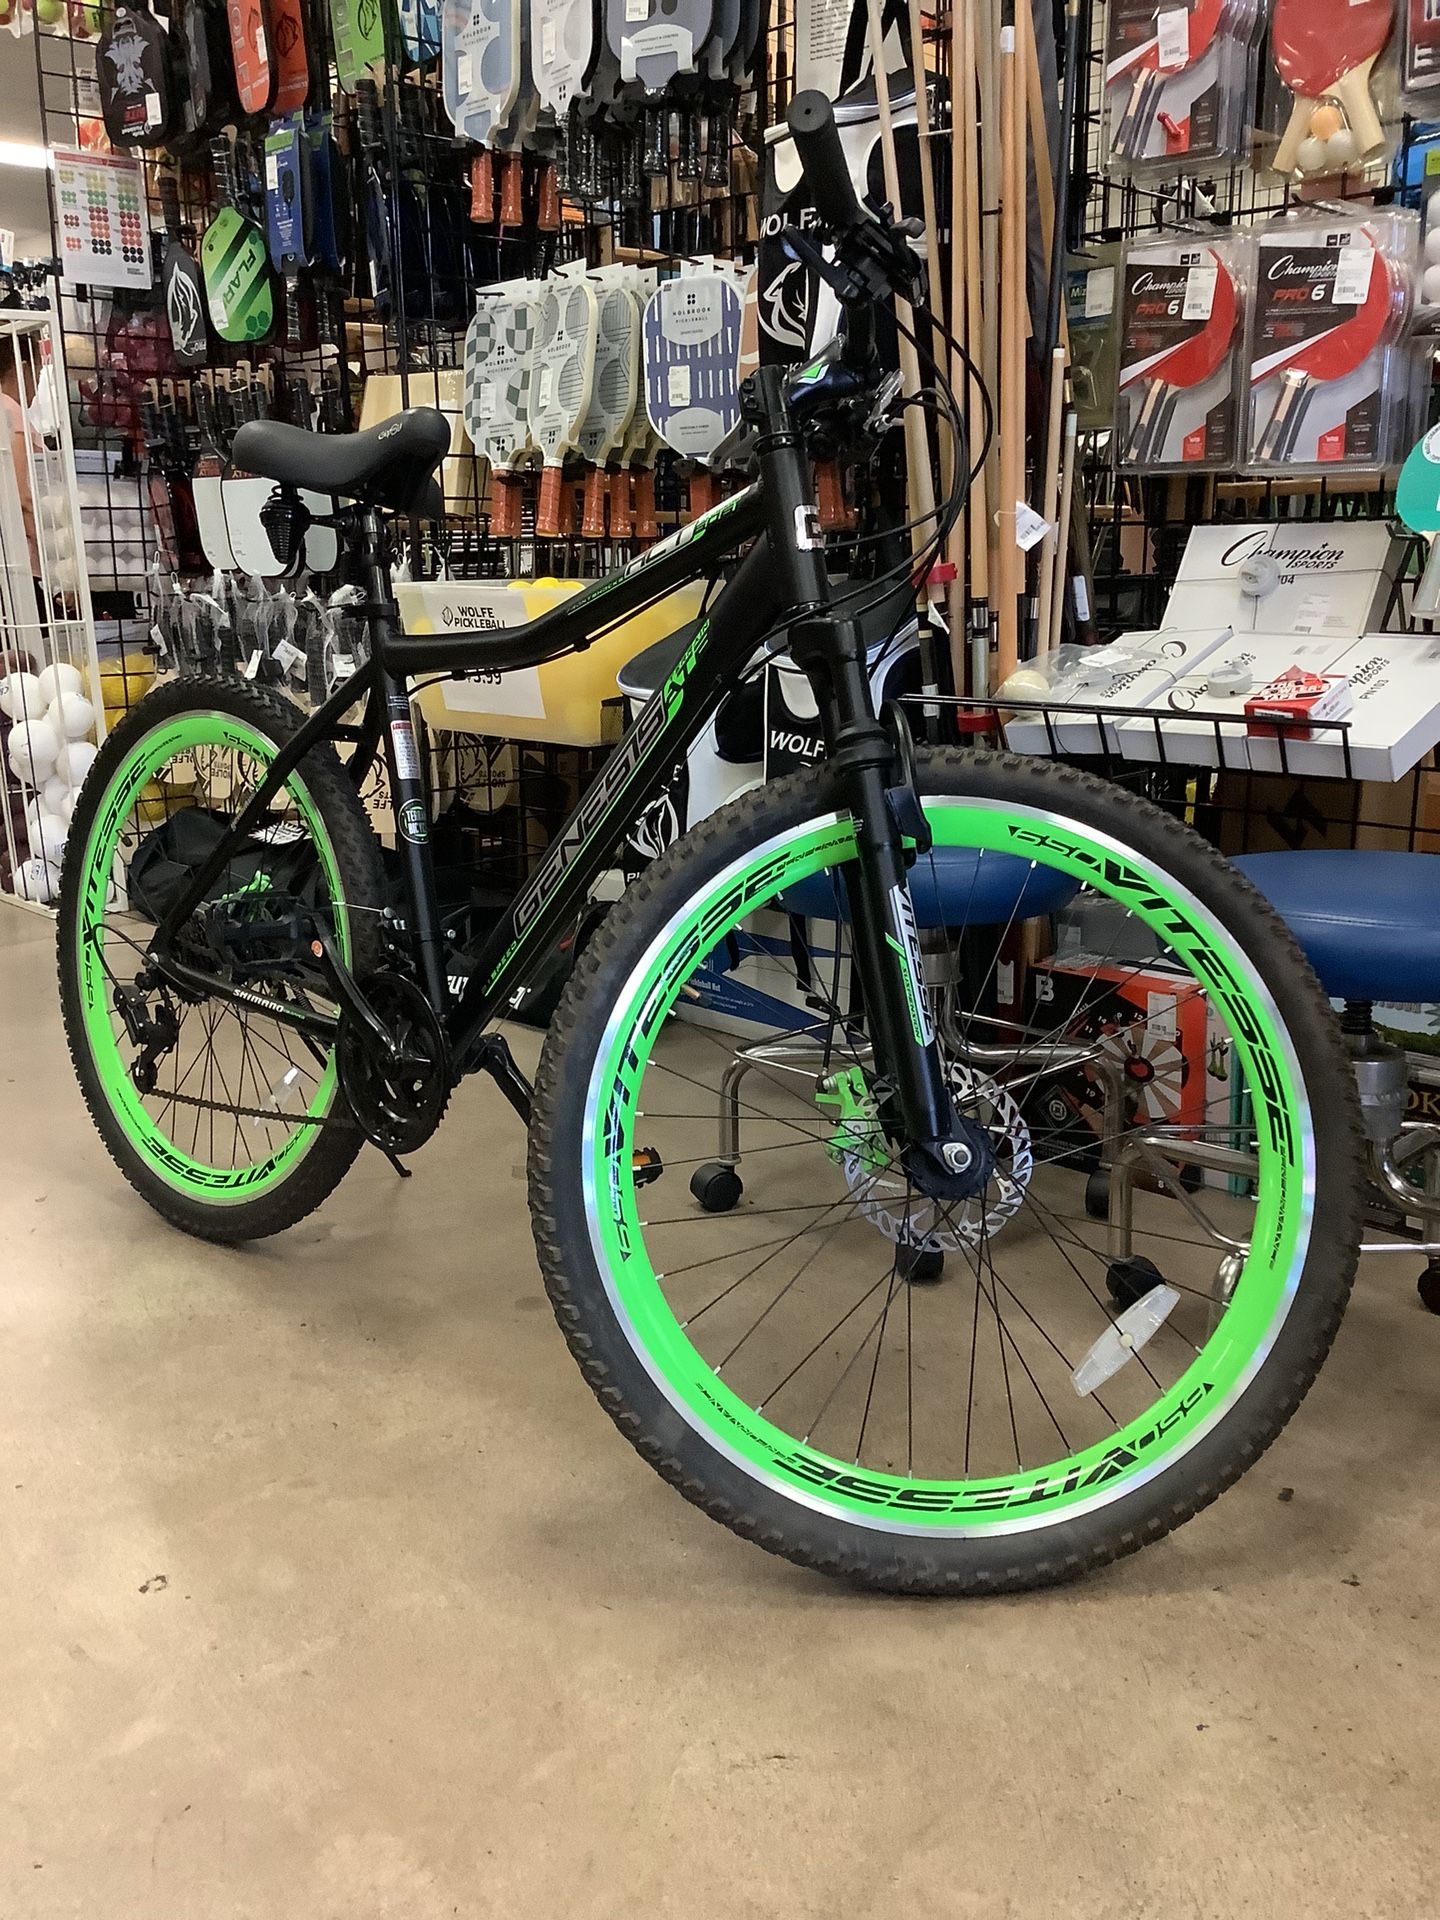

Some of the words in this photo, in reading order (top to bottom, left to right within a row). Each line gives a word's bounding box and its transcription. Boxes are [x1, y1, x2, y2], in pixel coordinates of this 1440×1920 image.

[224, 247, 257, 309] FLAR
[1272, 287, 1310, 301] PRO
[1311, 284, 1327, 301] 6
[672, 306, 711, 317] HOLBROOK
[1136, 303, 1167, 315] PRO
[1167, 300, 1180, 315] 6
[485, 357, 518, 367] HOLBROOK
[1291, 560, 1339, 570] SPORTS
[457, 606, 495, 619] WOLFE
[1364, 658, 1391, 683] SPORTS
[770, 730, 826, 758] WOLF
[514, 694, 665, 936] GENESIS
[83, 753, 148, 944] VITESSE
[897, 878, 933, 1036] VITESSE
[232, 988, 285, 1013] SHIMANO
[1035, 974, 1054, 1001] B
[603, 850, 793, 1160] VITESSE
[902, 967, 921, 1039] SUSPENSION
[1099, 857, 1296, 1168] VITESSE
[1085, 1087, 1096, 1098] 19
[141, 1136, 276, 1189] VITESSE
[772, 1444, 1140, 1513] VITESSE
